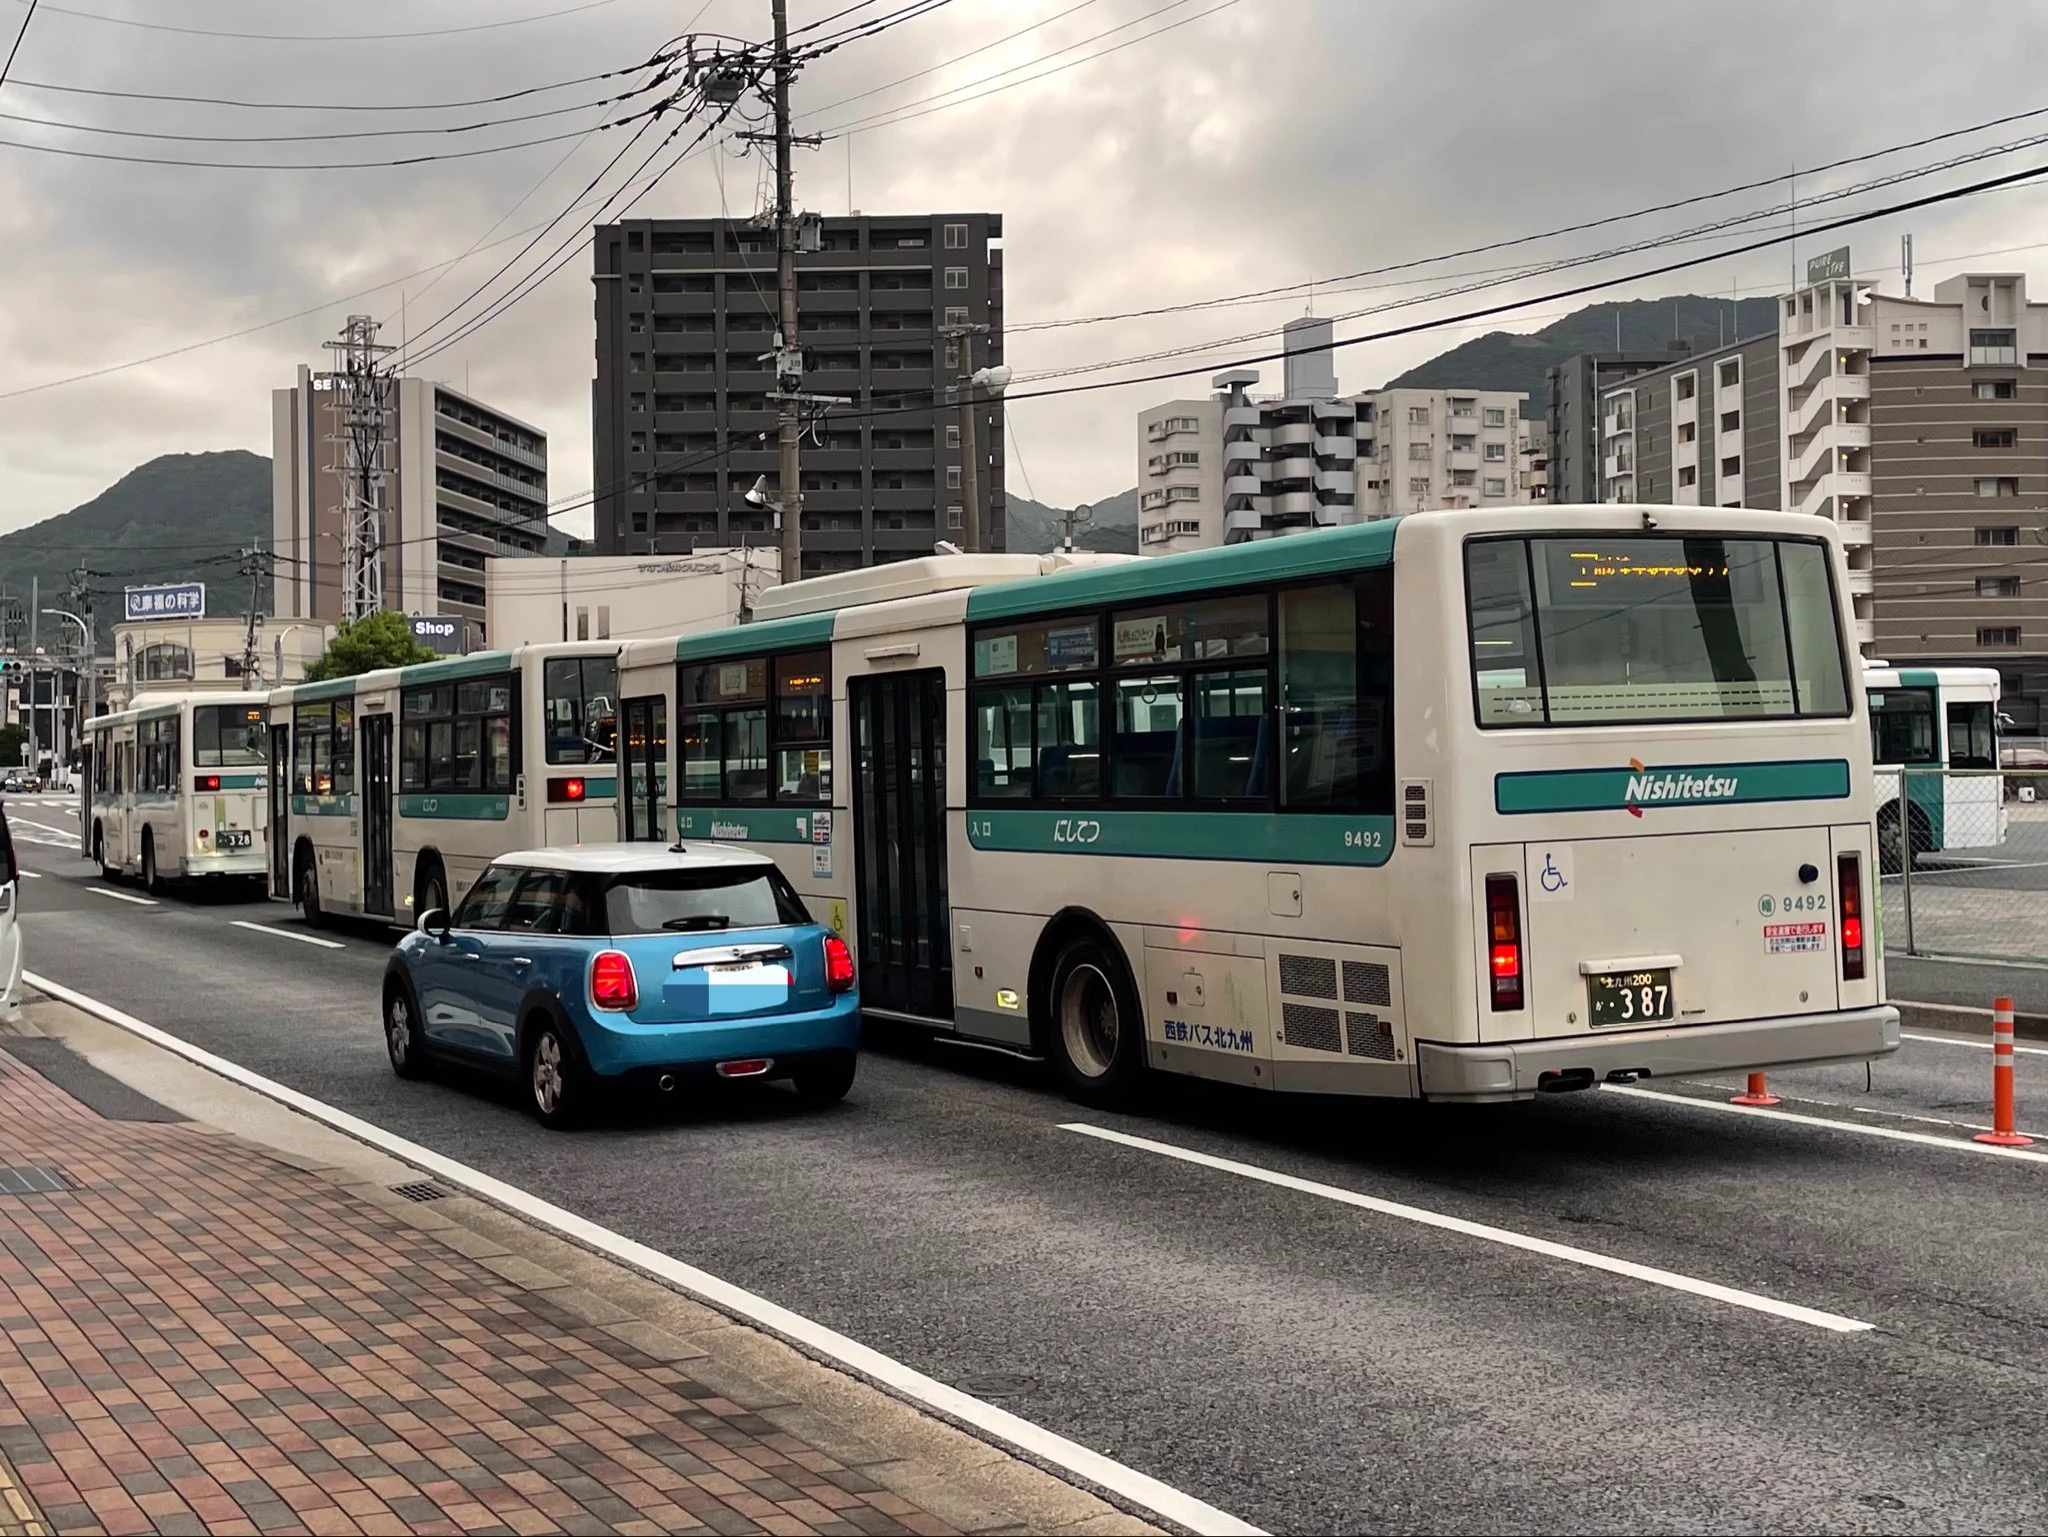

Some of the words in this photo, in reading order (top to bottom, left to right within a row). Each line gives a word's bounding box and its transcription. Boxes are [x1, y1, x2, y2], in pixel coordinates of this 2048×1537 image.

[1809, 254, 1832, 271] PURE
[415, 621, 455, 637] Shop
[1624, 774, 1738, 801] Nishitetsu
[972, 821, 992, 837] 入口
[1053, 819, 1101, 843] にしてつ
[1344, 830, 1382, 848] 9492
[1783, 894, 1827, 912] 9492
[1163, 1019, 1254, 1053] 西鉄バス北九州
